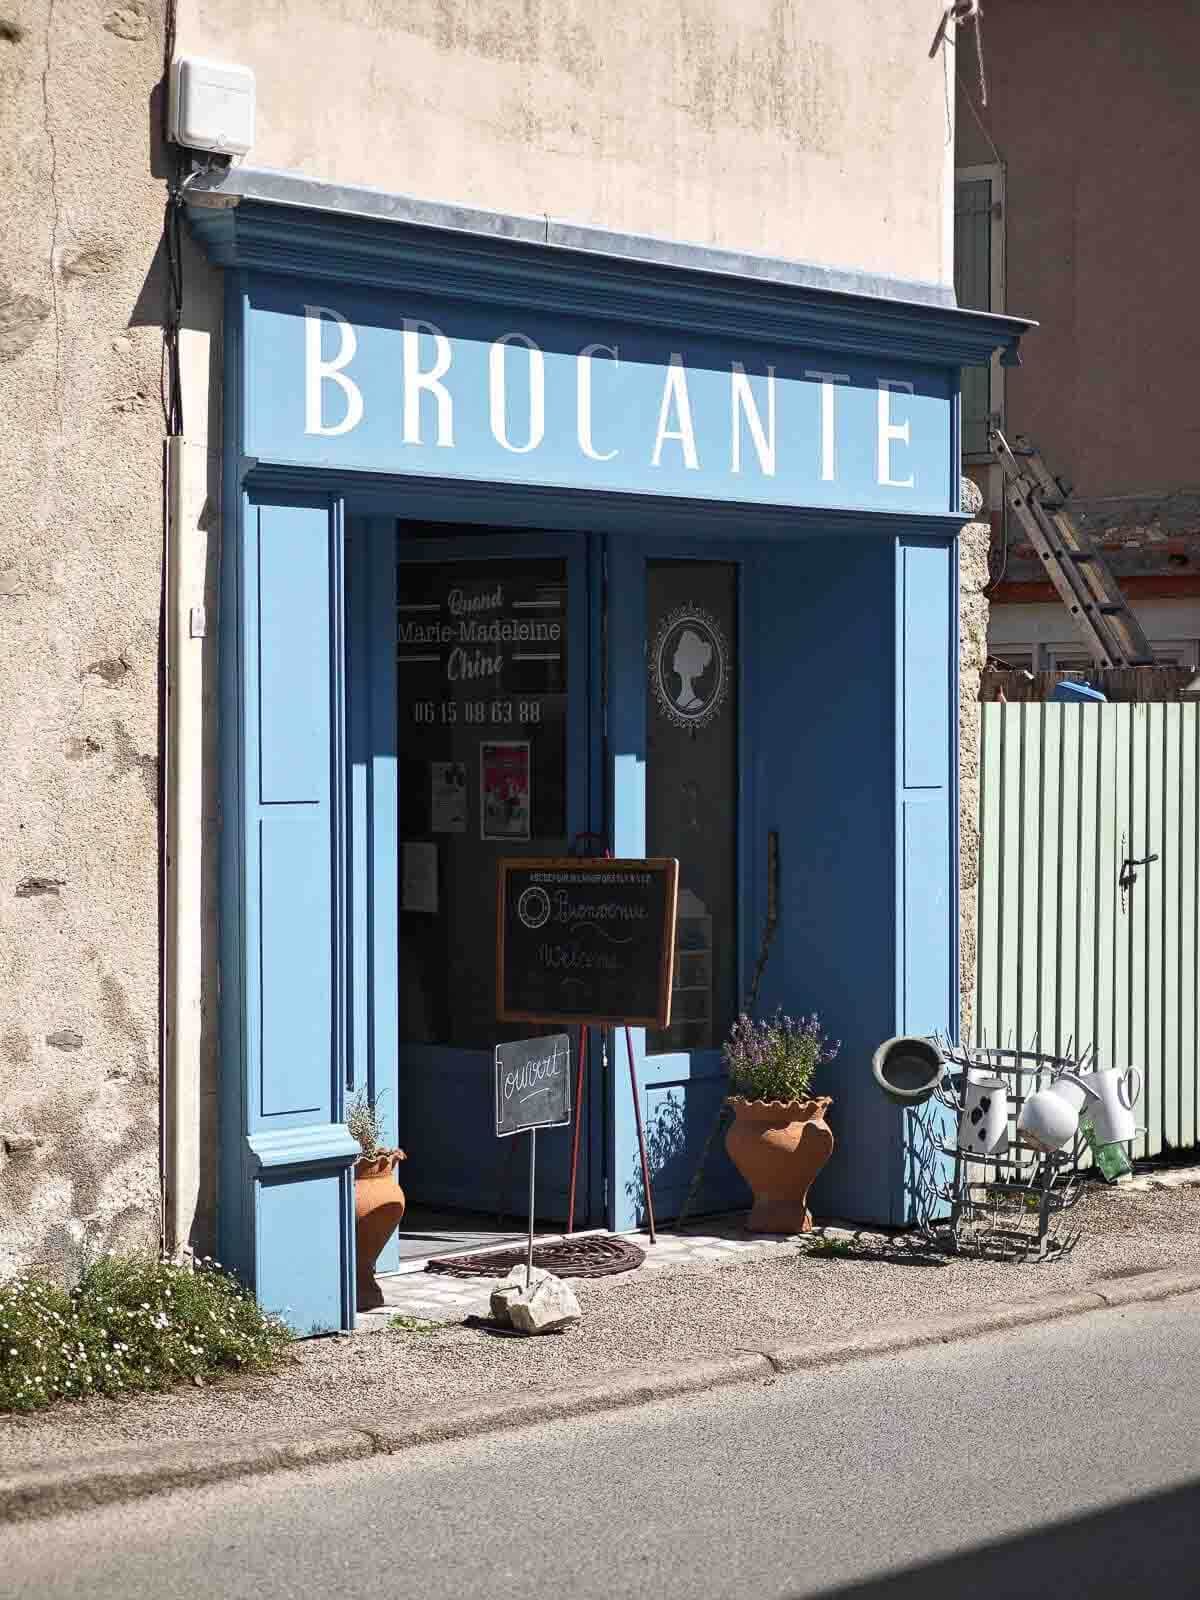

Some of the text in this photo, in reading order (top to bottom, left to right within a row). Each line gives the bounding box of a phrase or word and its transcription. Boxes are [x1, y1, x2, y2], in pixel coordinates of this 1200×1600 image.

[302, 303, 917, 489] BROCANTE
[447, 585, 504, 616] Quand
[447, 647, 505, 681] Chine
[415, 701, 540, 722] 06 15 08 63 88
